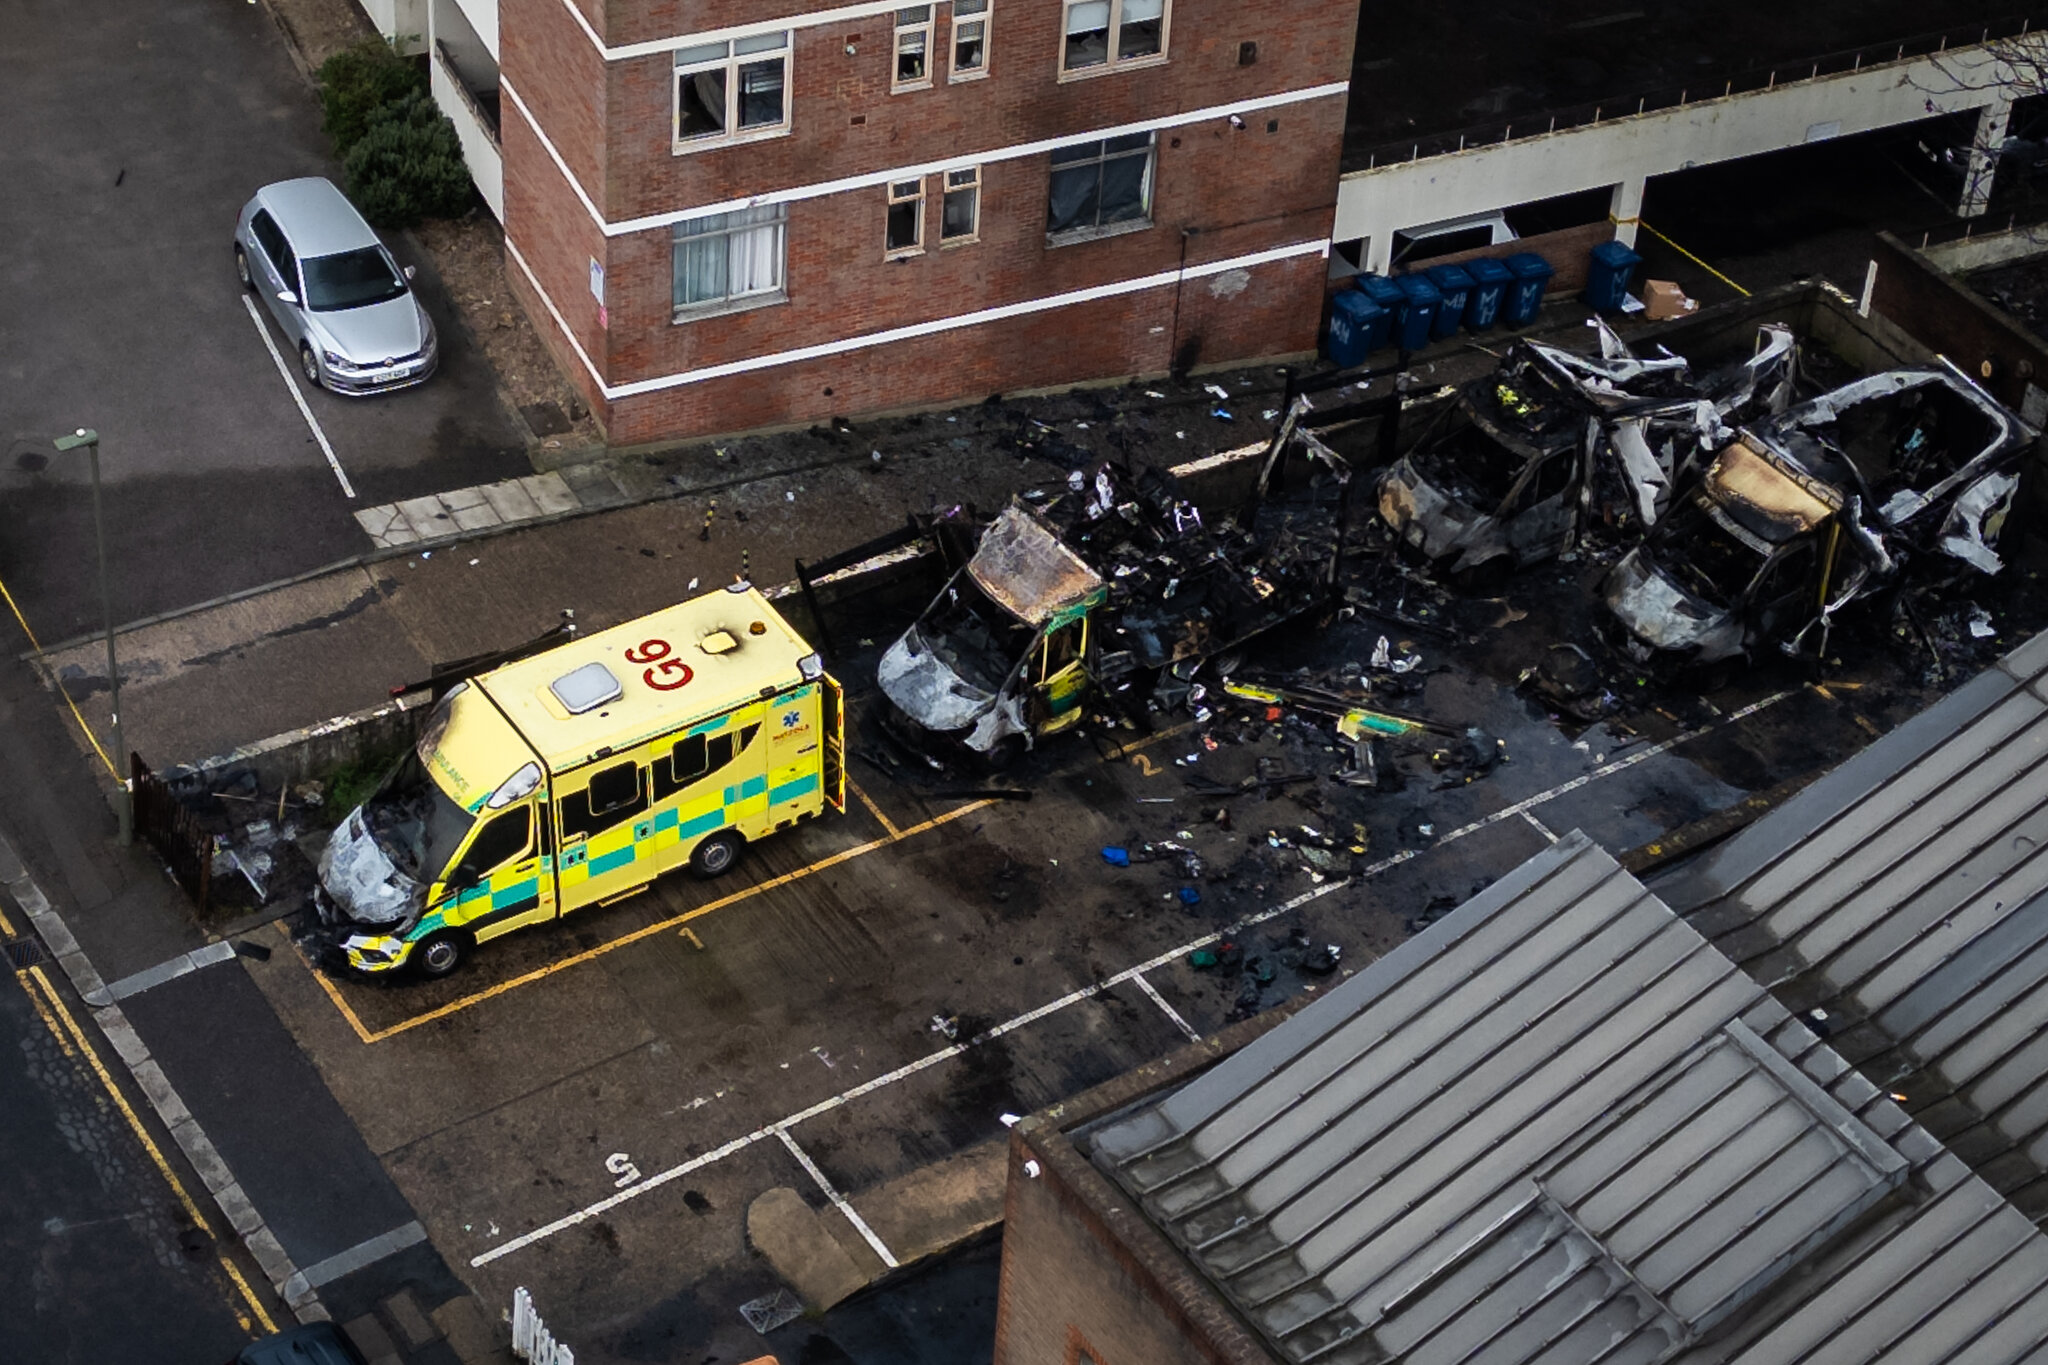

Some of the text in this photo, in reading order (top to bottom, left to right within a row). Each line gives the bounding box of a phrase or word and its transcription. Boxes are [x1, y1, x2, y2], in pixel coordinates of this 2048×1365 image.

[624, 639, 694, 691] G6
[1132, 753, 1163, 777] 2
[678, 927, 705, 950] 1
[604, 1152, 642, 1188] 5
